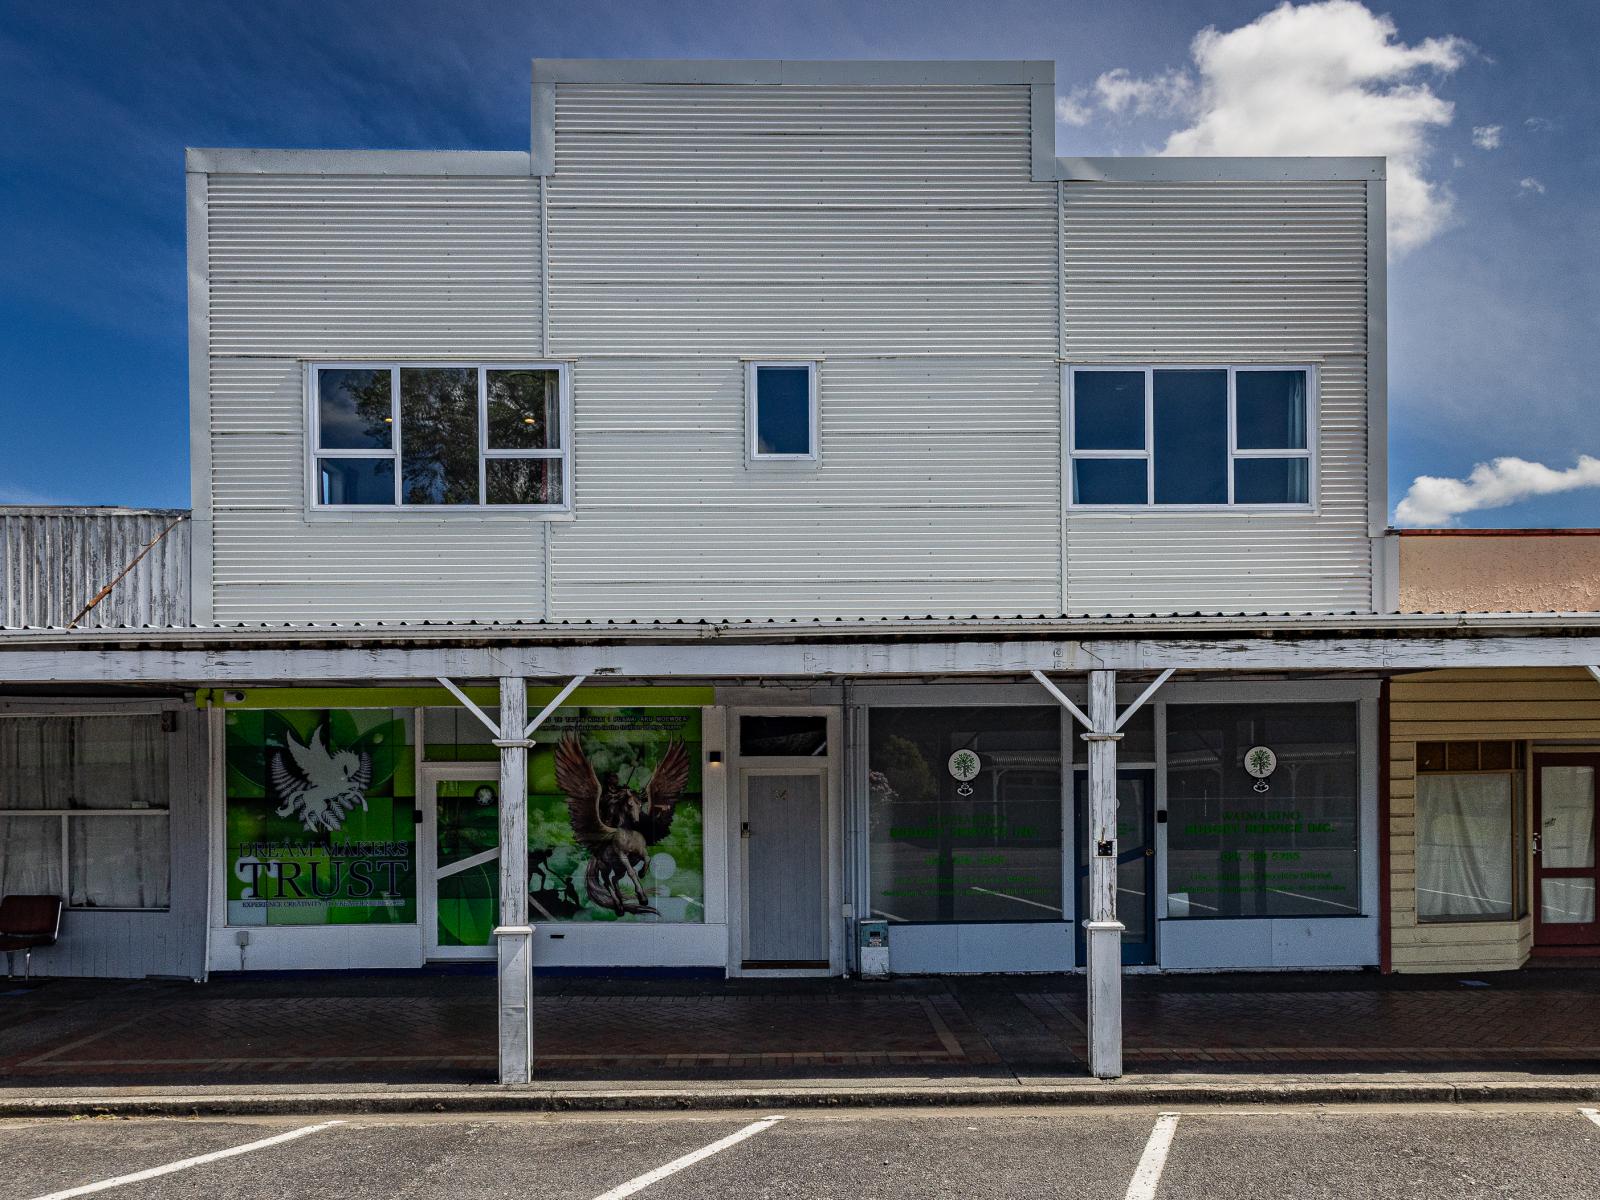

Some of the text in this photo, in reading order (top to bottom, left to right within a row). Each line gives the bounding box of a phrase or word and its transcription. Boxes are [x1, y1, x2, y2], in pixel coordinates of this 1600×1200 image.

[239, 839, 408, 858] DREAM MAKERS
[239, 860, 409, 899] TRUST
